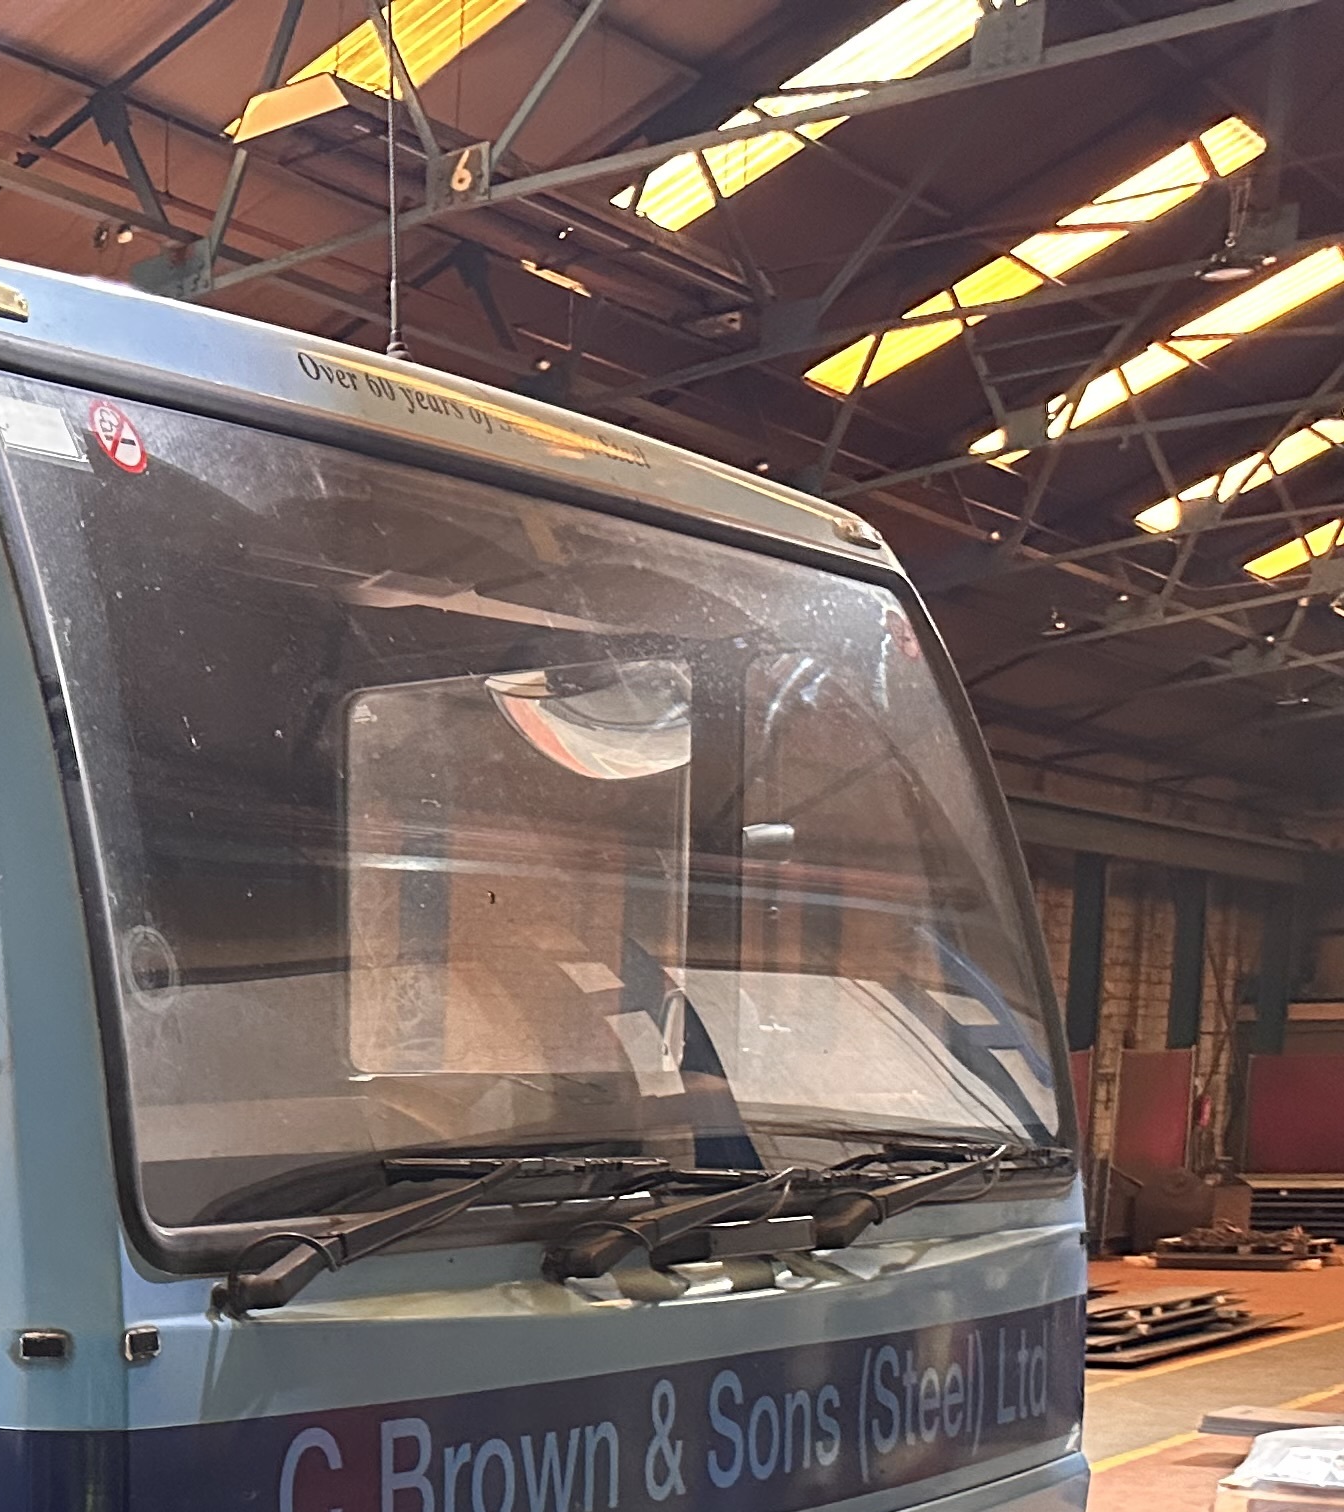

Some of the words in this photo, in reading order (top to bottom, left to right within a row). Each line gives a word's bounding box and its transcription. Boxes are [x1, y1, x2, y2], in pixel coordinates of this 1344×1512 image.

[297, 351, 358, 391] Over
[365, 372, 396, 401] 60
[399, 385, 465, 420] years
[469, 405, 493, 435] of
[644, 1378, 687, 1501] &
[707, 1368, 842, 1489] Sons
[858, 1329, 985, 1484] (Steel)
[996, 1319, 1048, 1425] Ltd
